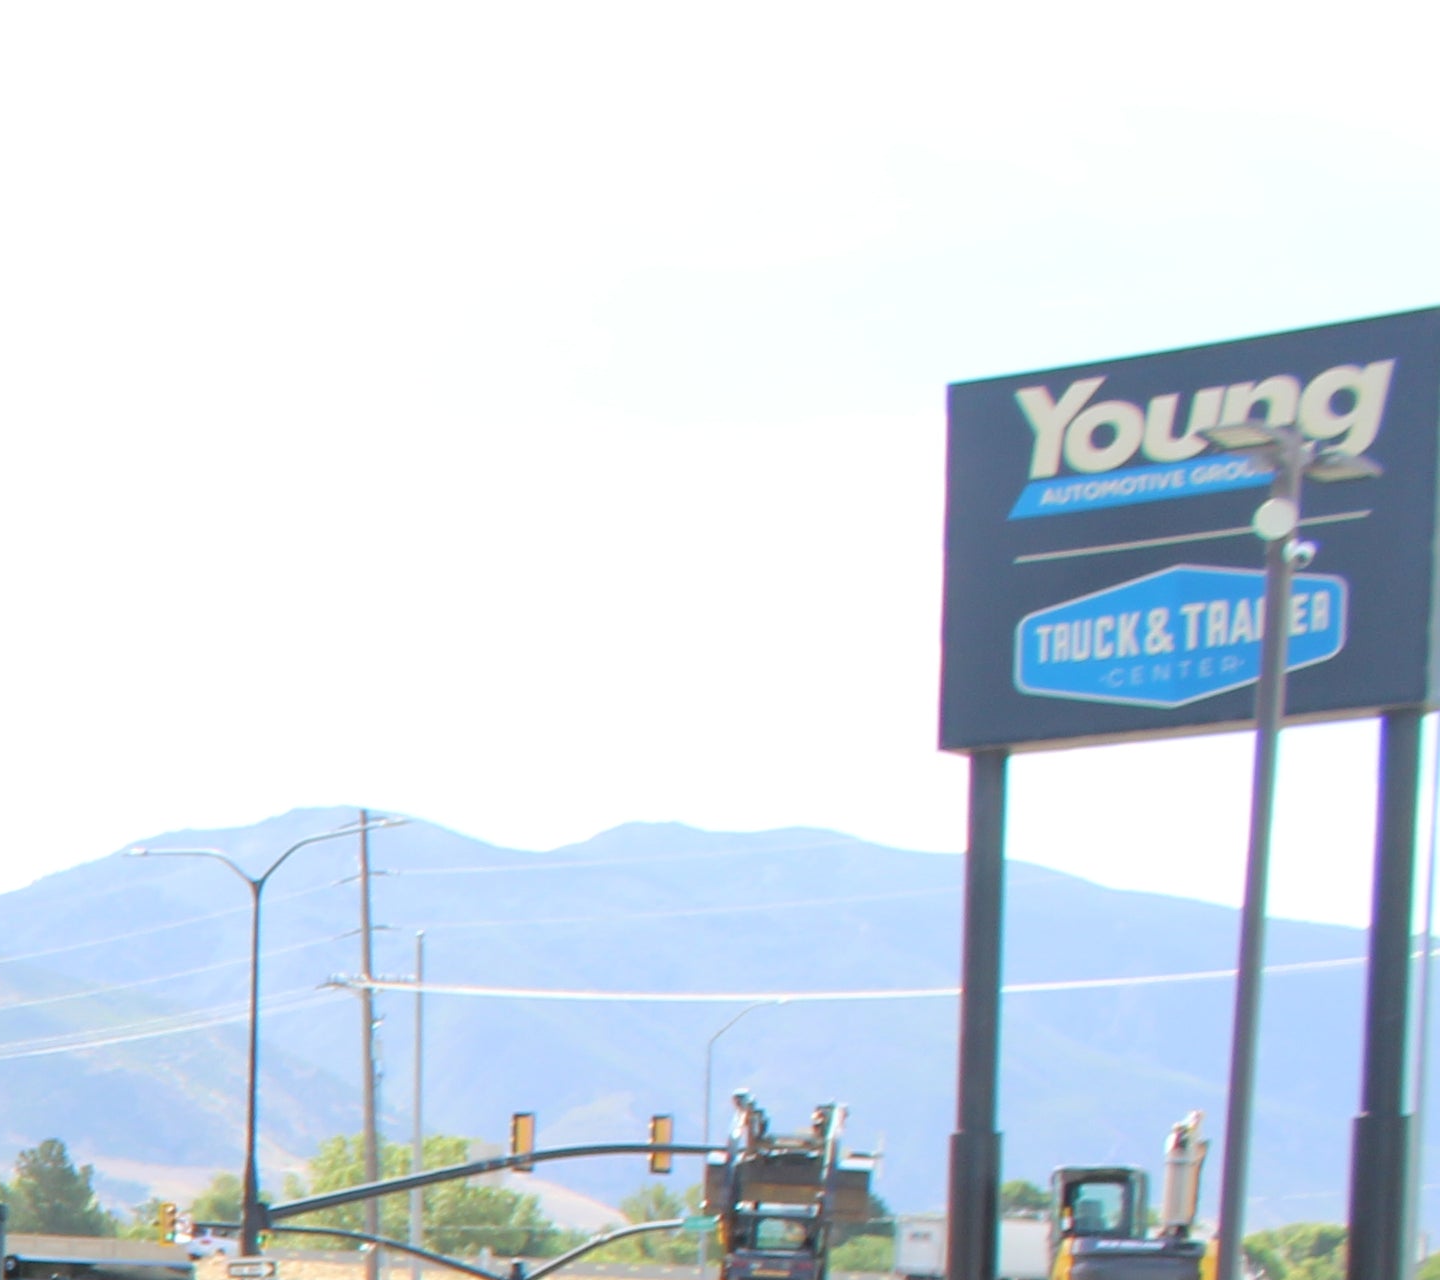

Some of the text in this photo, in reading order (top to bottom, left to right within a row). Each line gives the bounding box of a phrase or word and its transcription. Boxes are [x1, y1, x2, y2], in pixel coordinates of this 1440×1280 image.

[1014, 358, 1396, 481] Young
[1040, 460, 1259, 506] AUTOMOTIVE GROU
[1036, 590, 1330, 663] TRUCK & TRAIER
[1109, 656, 1239, 688] CENTER
